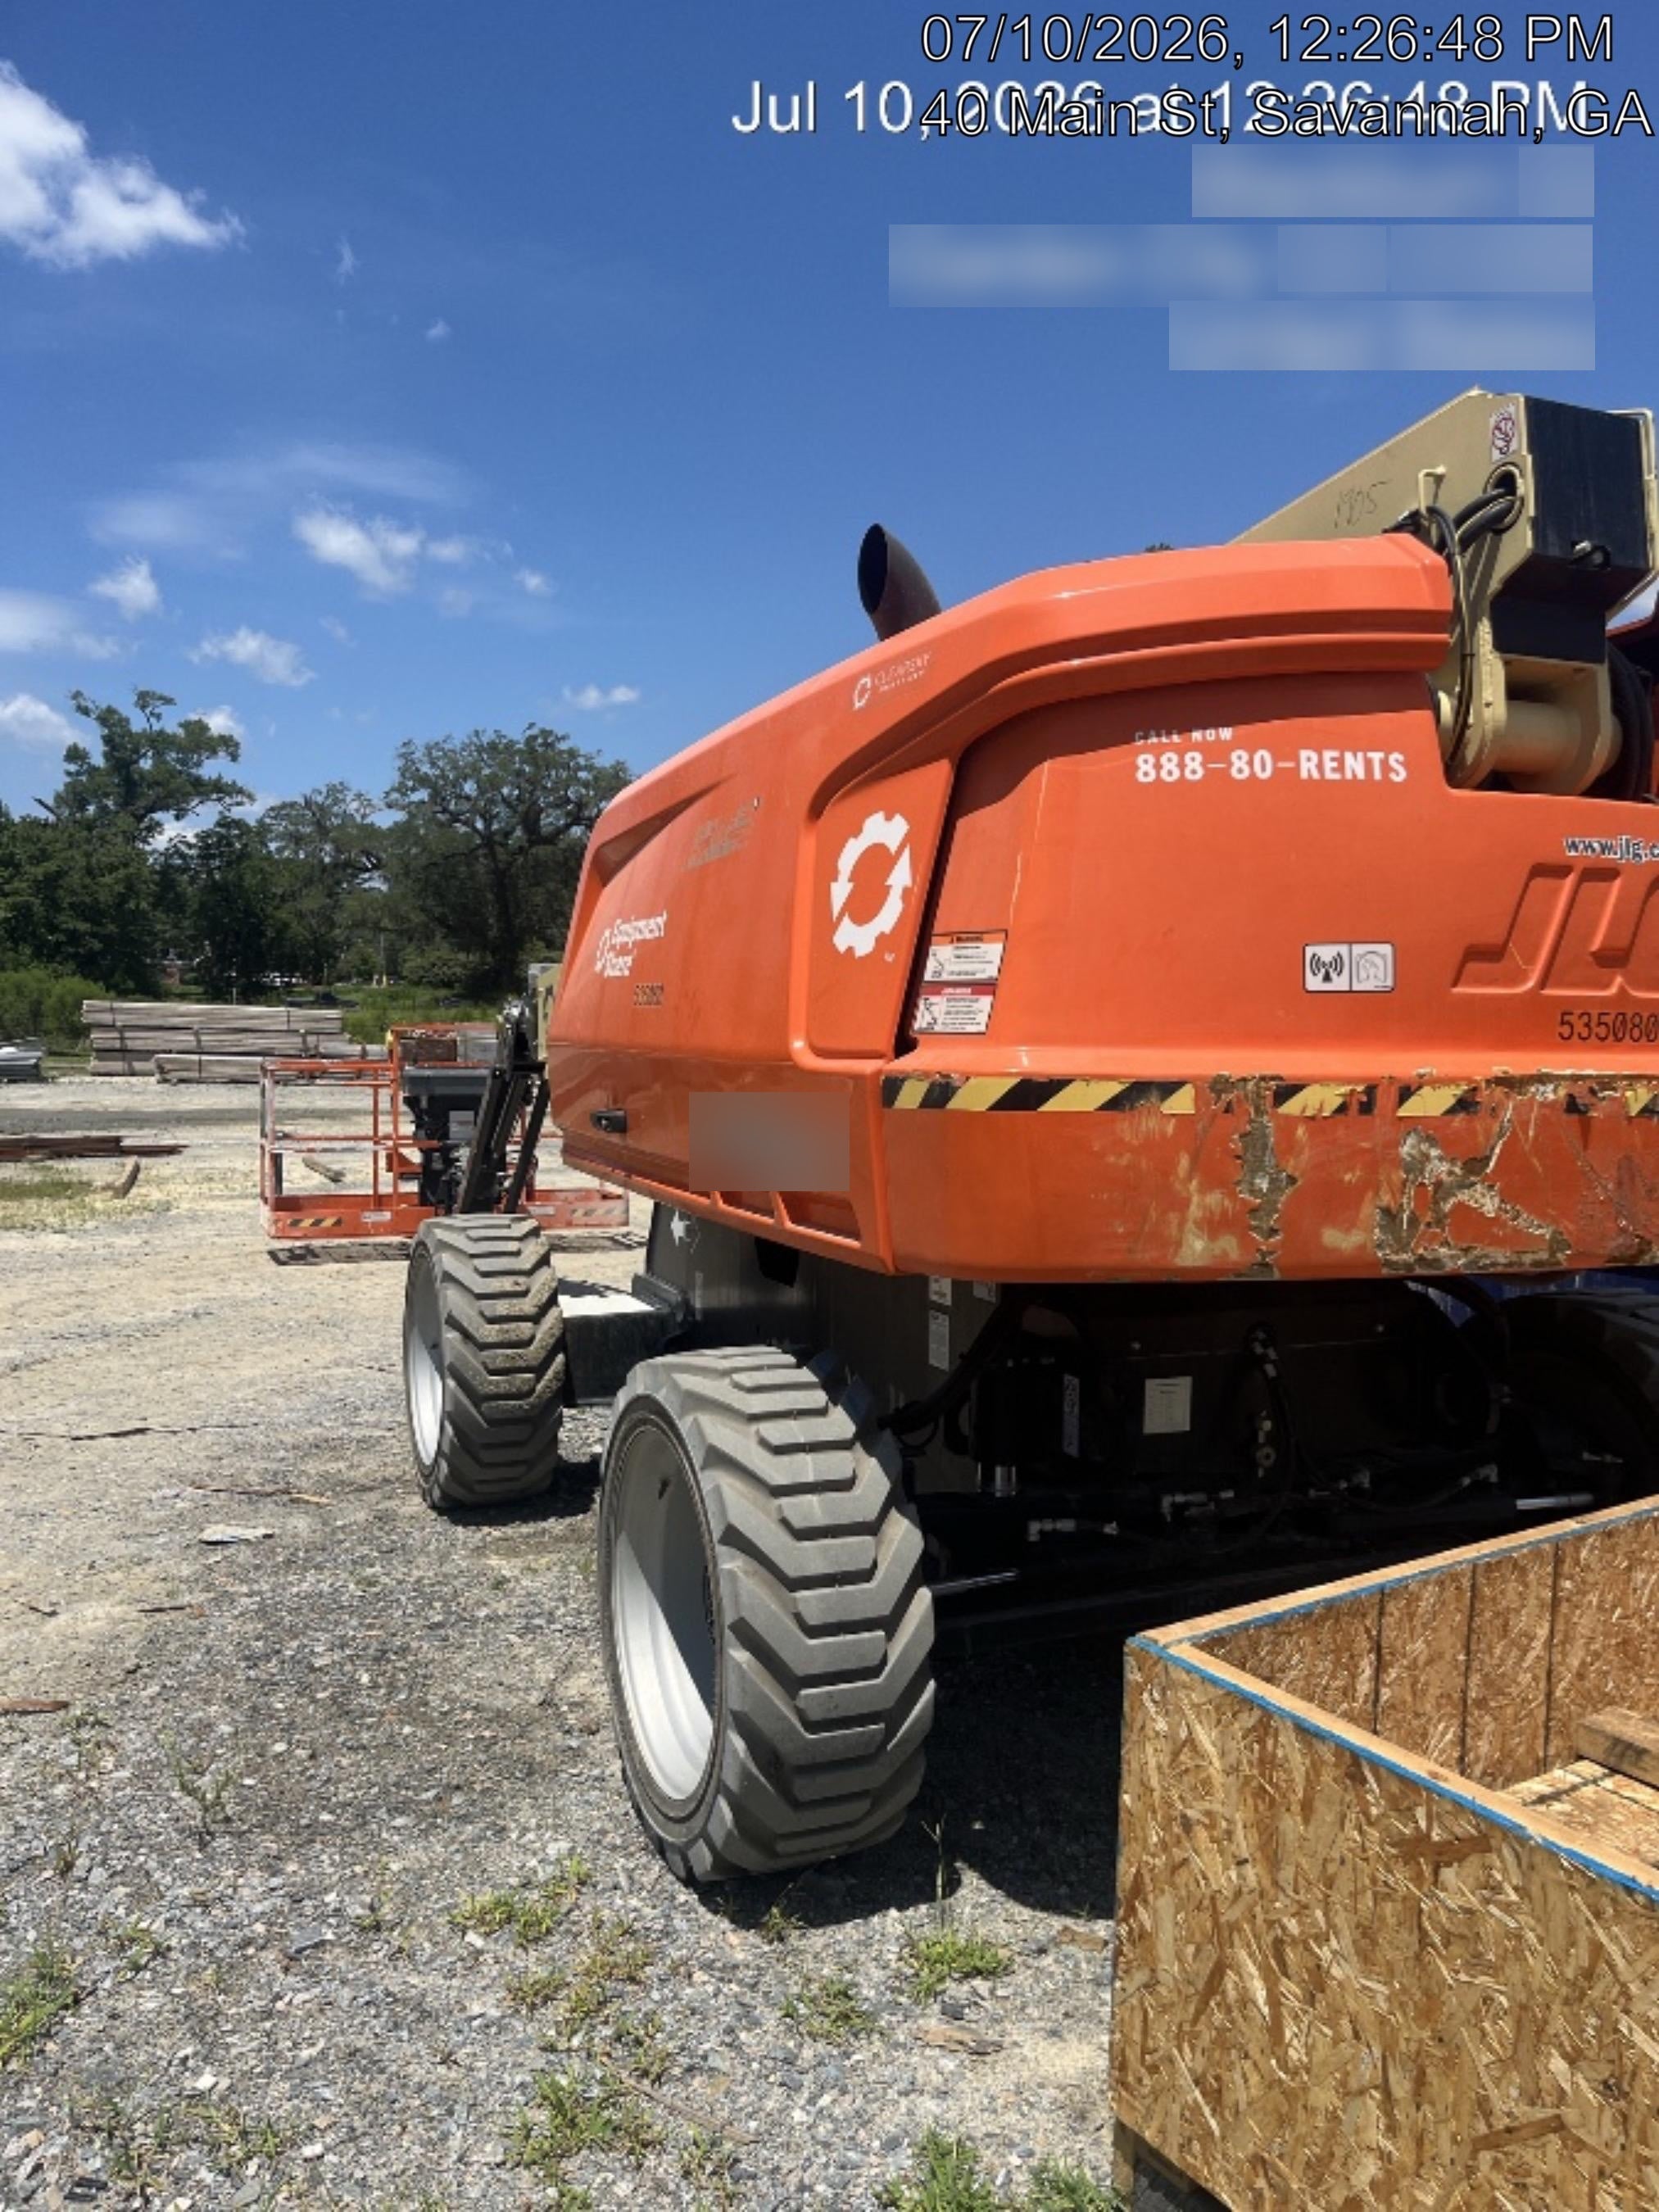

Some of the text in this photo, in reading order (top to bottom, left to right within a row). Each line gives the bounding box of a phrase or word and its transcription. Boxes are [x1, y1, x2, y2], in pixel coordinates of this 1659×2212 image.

[1134, 727, 1233, 746] CALL NOW
[1135, 748, 1407, 783] 888-80-RENTS
